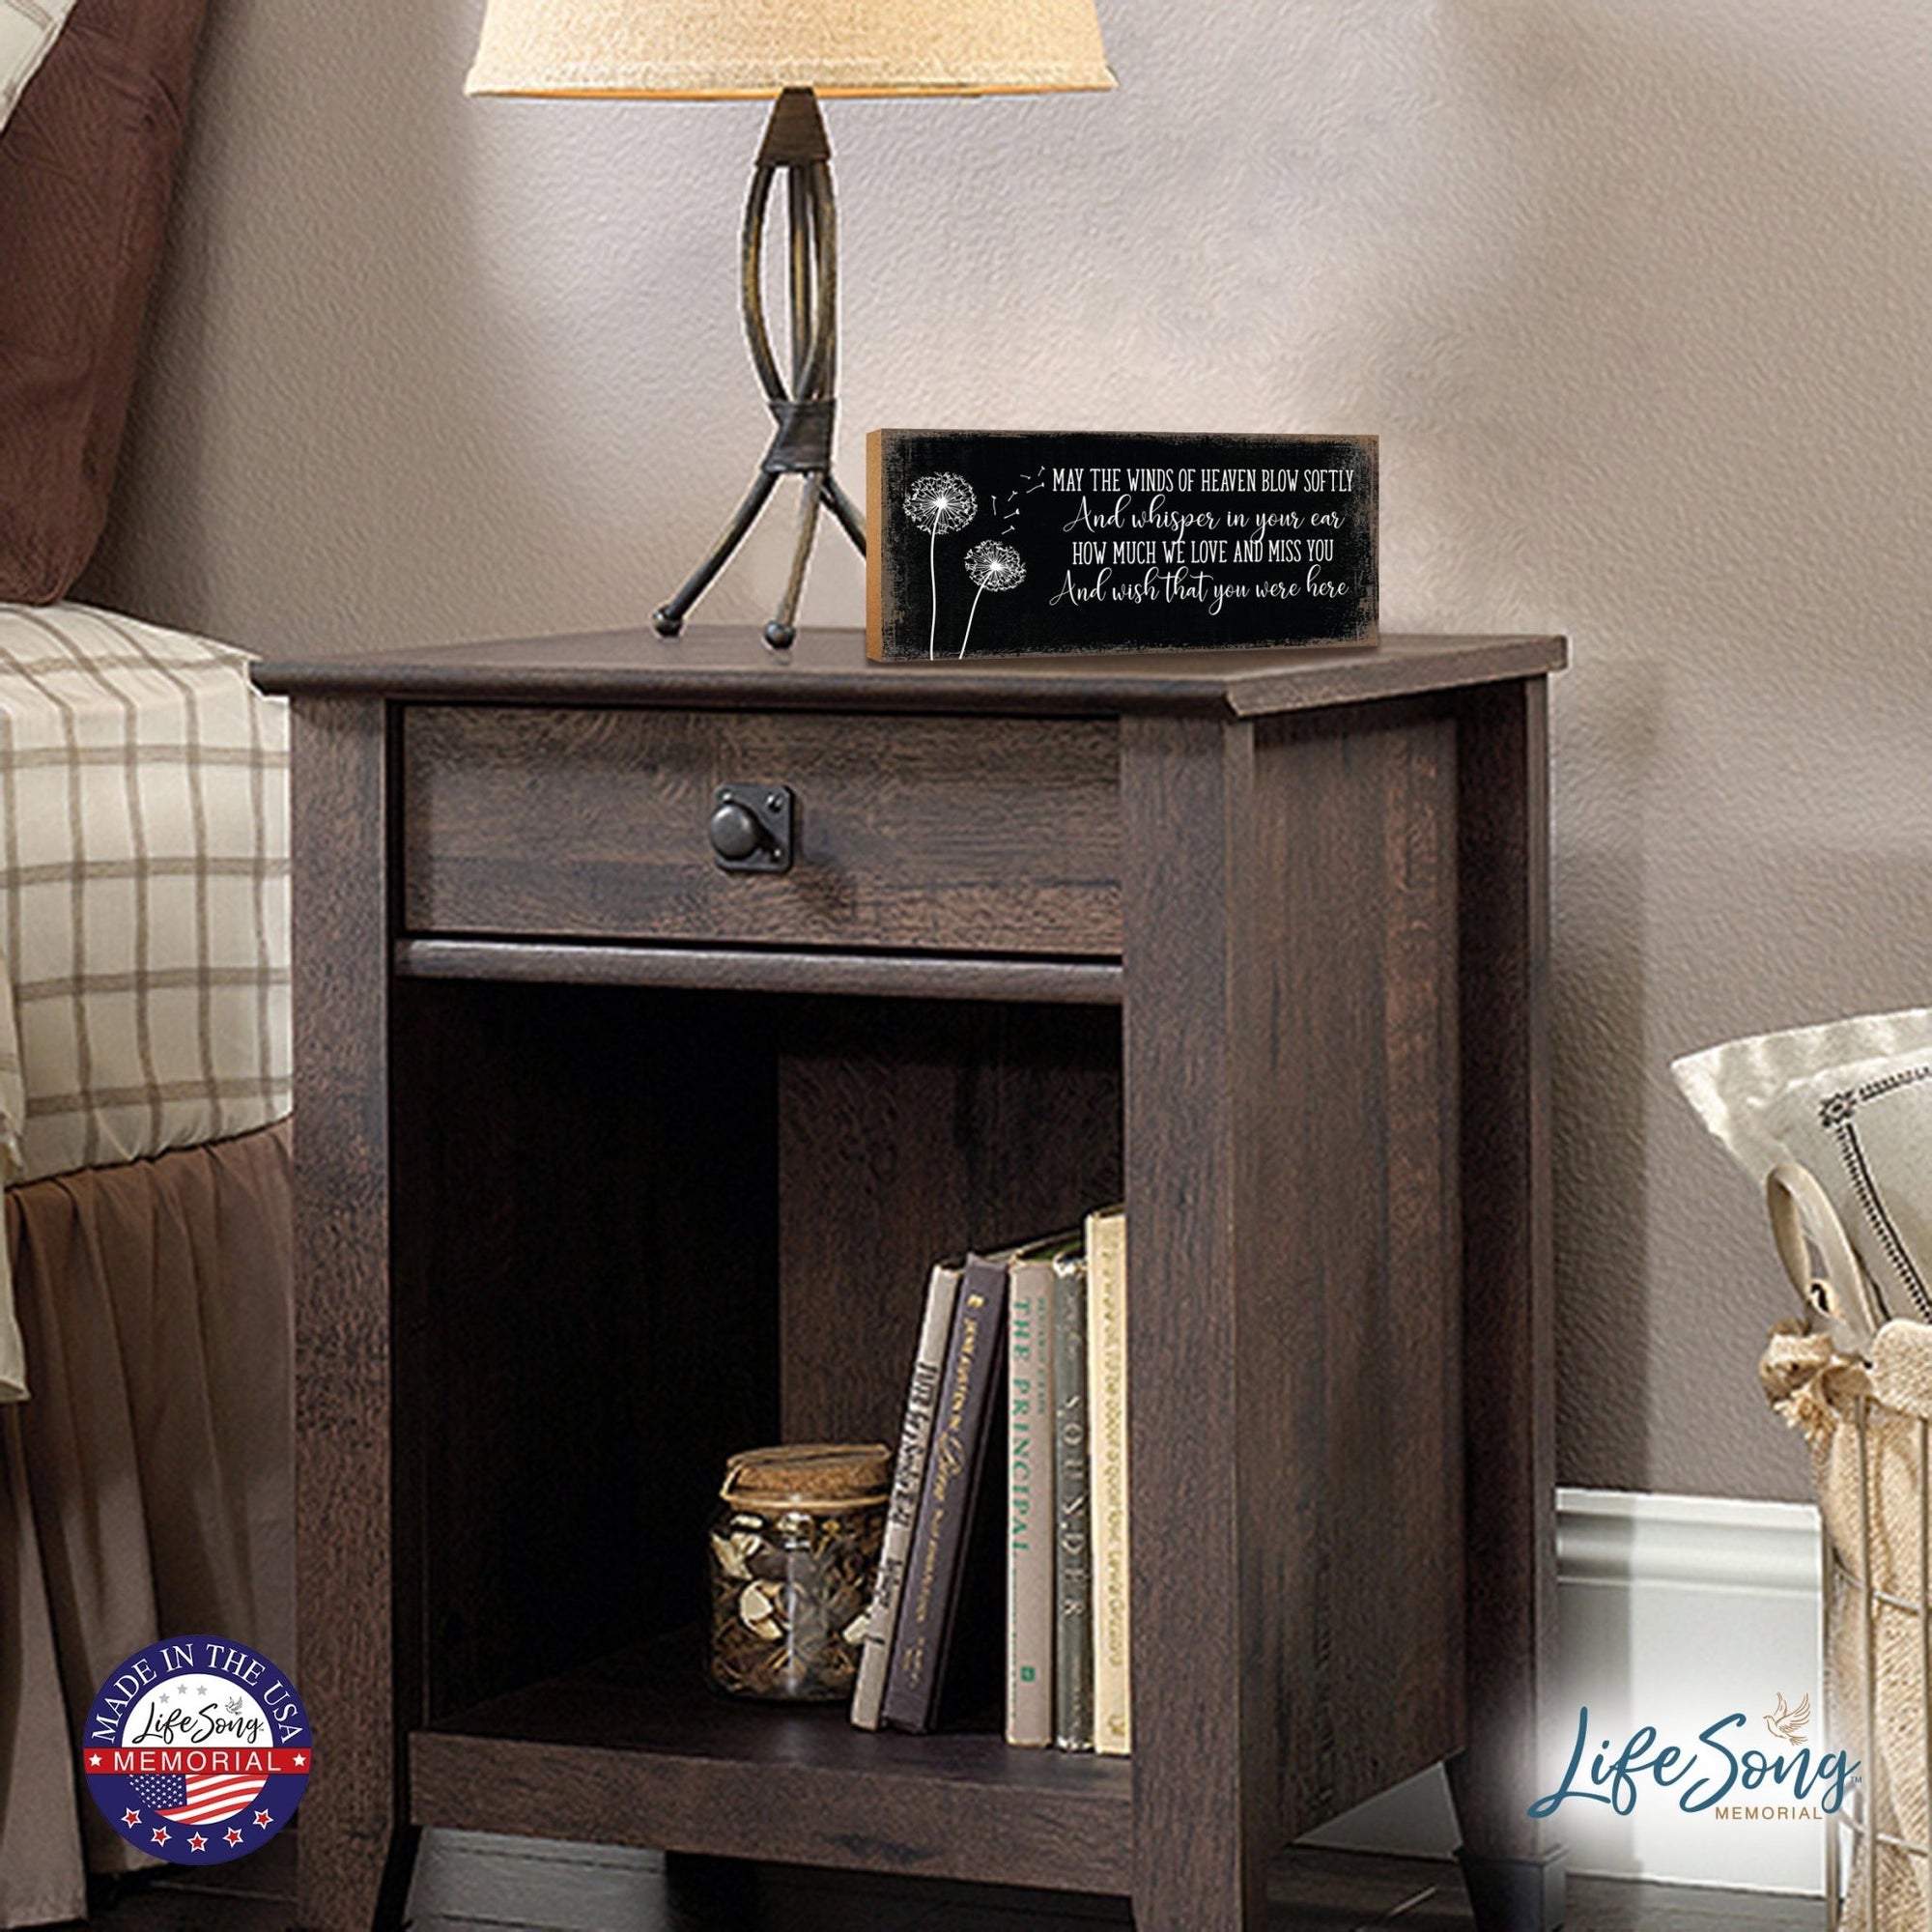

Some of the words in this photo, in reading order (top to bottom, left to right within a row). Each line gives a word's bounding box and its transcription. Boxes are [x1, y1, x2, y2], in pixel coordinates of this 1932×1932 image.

[1052, 468, 1085, 493] MAY
[1089, 468, 1122, 493] THE
[1126, 468, 1174, 493] WINDS
[1178, 468, 1196, 493] OF
[1201, 468, 1257, 493] HEAVEN
[1261, 468, 1299, 493] BLOW
[1303, 468, 1355, 493] SOFTLY
[1063, 494, 1132, 533] And
[1131, 494, 1221, 544] whisper
[1227, 510, 1250, 528] in
[1250, 511, 1305, 544] your
[1311, 511, 1346, 529] ear
[1072, 540, 1107, 565] HOW
[1112, 540, 1156, 565] MUCH
[1162, 540, 1186, 565] WE
[1190, 540, 1228, 565] LOVE
[1233, 540, 1264, 565] AND
[1267, 540, 1302, 565] MISS
[1306, 540, 1334, 565] YOU
[1049, 566, 1113, 606] And
[1112, 566, 1160, 605] wish
[1157, 566, 1214, 604] that
[1208, 583, 1250, 616] you
[1255, 581, 1302, 599] were
[1306, 564, 1350, 598] here
[1013, 1298, 1031, 1363] THE
[1012, 1378, 1031, 1551] PRINCIPAL
[1063, 1395, 1086, 1615] SOUNDER
